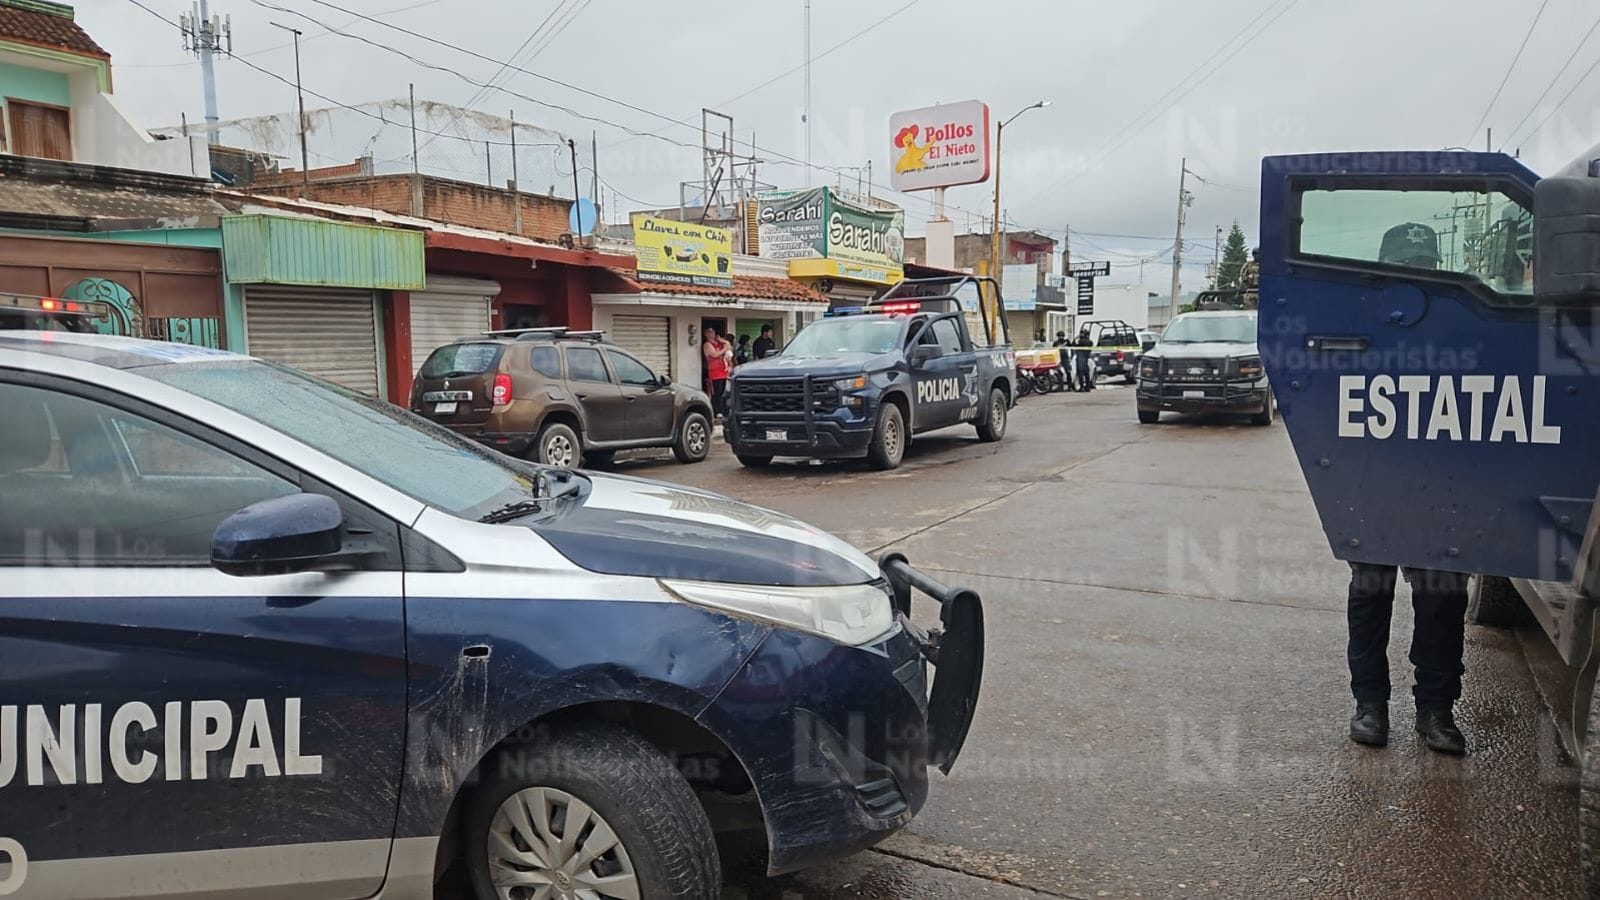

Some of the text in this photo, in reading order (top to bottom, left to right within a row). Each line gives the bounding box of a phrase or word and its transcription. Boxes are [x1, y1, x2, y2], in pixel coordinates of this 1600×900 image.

[925, 123, 973, 143] Pollos
[929, 143, 975, 159] El Nieto
[761, 198, 822, 223] Sarahí
[640, 219, 680, 235] Llaves
[683, 231, 702, 239] con
[705, 229, 728, 244] Chip
[830, 211, 885, 254] Sarahí
[917, 377, 960, 403] POLICIA
[1338, 374, 1561, 444] ESTATAL
